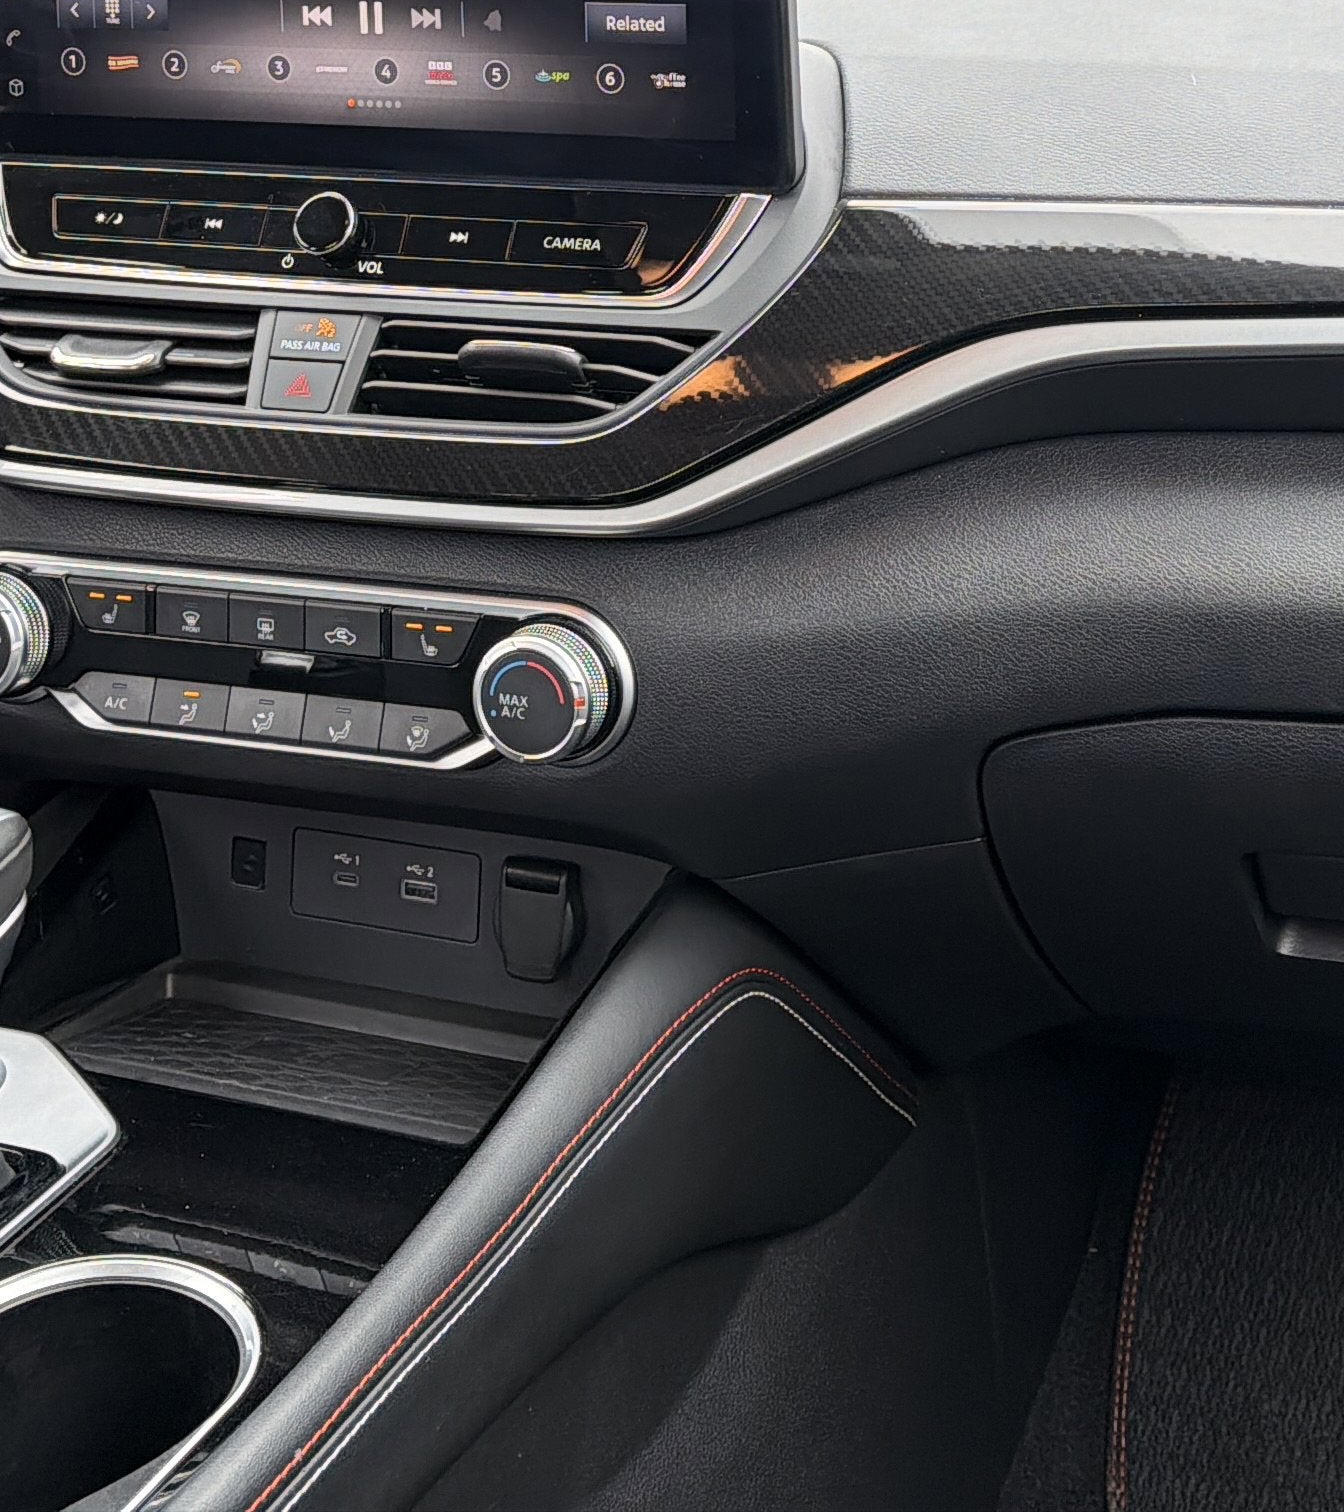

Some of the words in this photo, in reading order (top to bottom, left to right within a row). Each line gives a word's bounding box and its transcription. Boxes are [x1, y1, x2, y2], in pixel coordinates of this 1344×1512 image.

[605, 15, 666, 33] Related
[551, 70, 570, 82] spa
[543, 236, 602, 251] CAMERA
[357, 260, 384, 275] VOL
[280, 339, 305, 350] PASS
[303, 340, 320, 351] AIR
[321, 342, 341, 352] BAG
[182, 625, 201, 634] FRONT
[104, 696, 128, 710] A/C
[499, 692, 529, 708] MAX
[500, 705, 526, 720] A/C
[426, 866, 434, 878] 2
